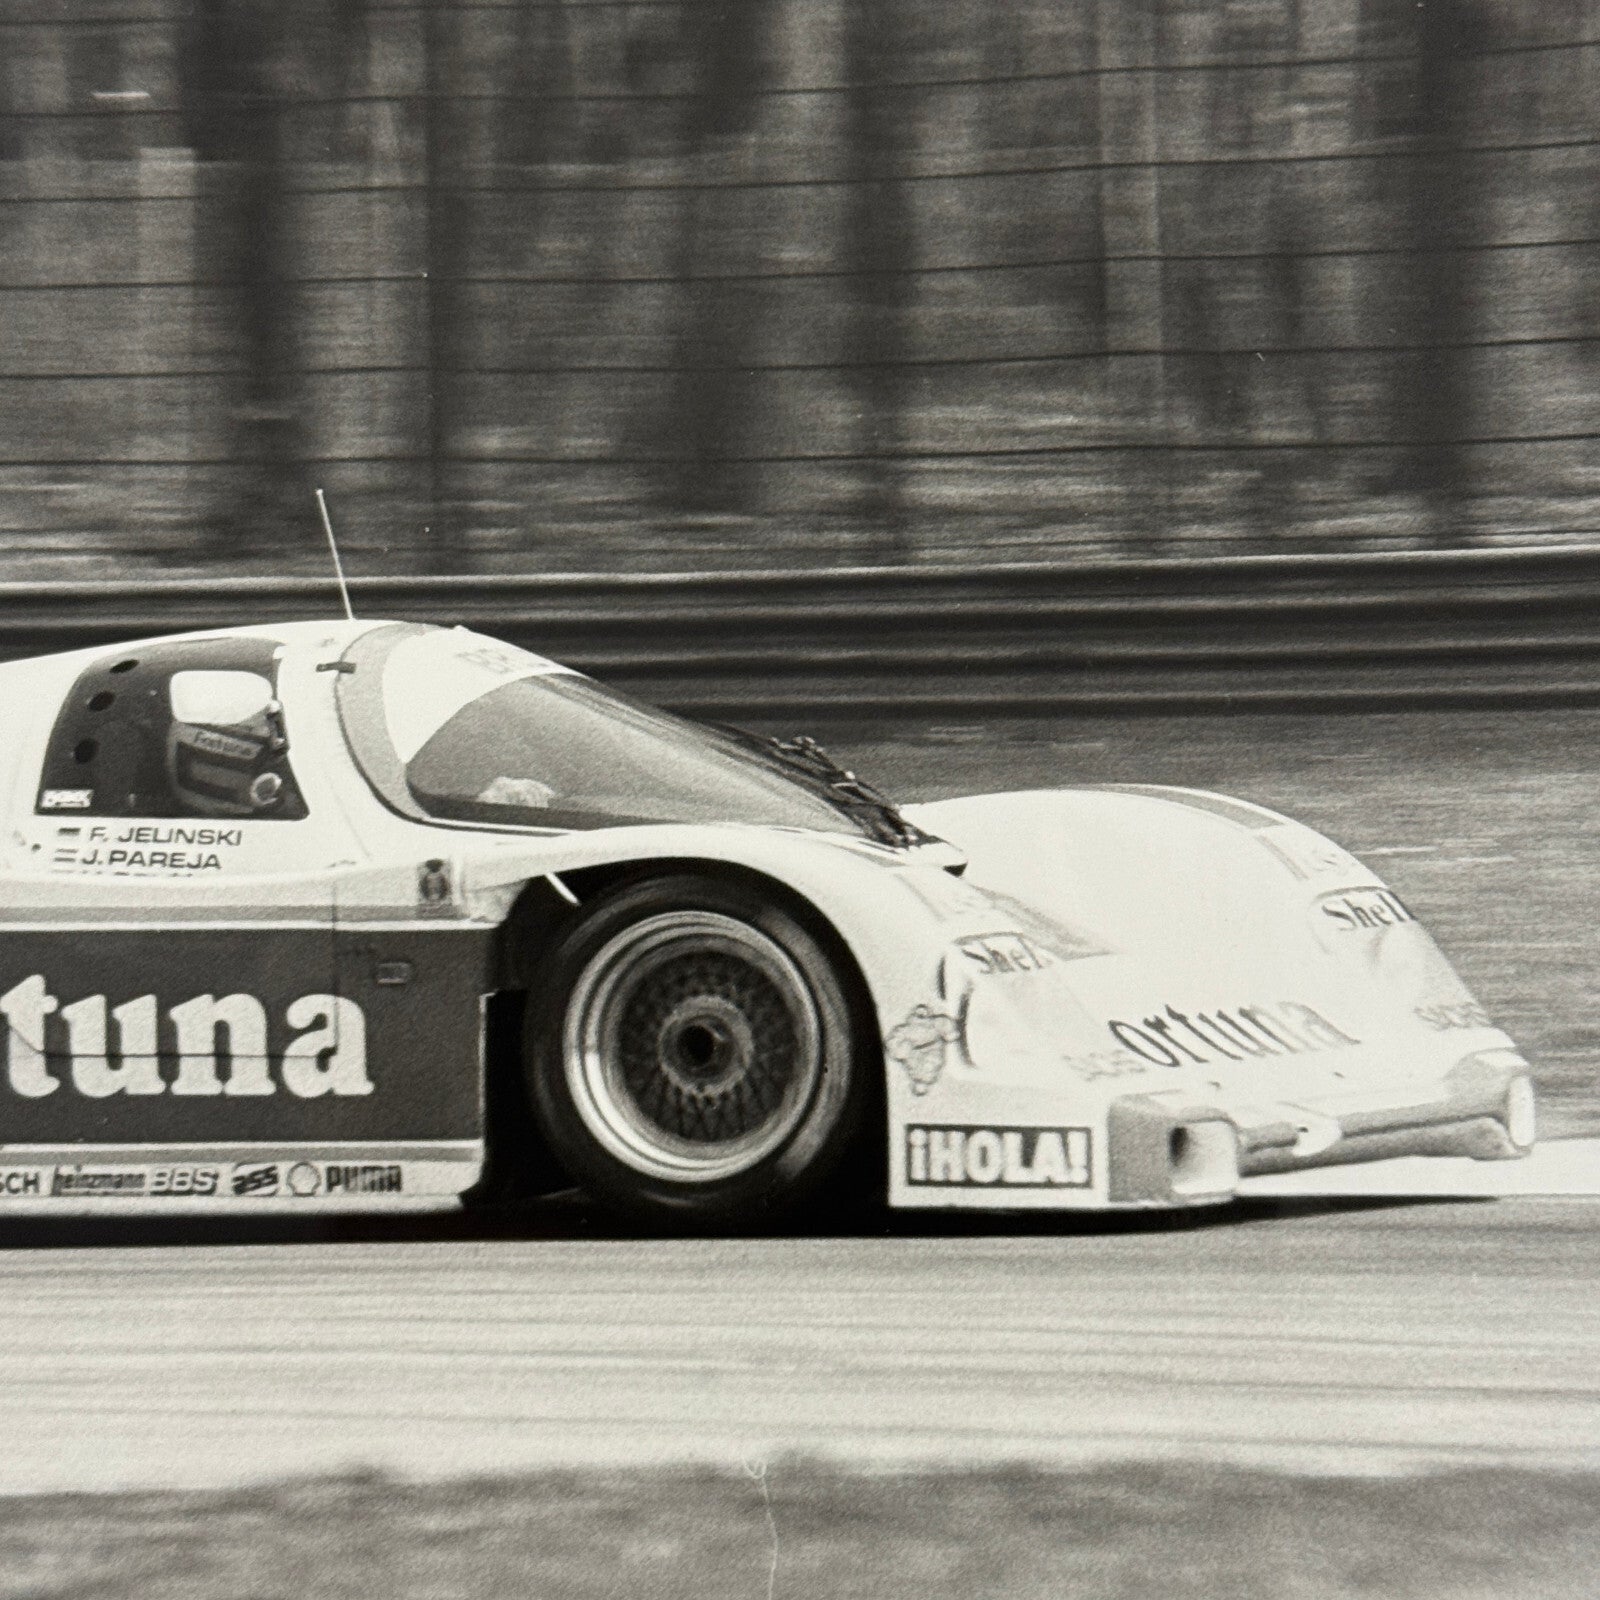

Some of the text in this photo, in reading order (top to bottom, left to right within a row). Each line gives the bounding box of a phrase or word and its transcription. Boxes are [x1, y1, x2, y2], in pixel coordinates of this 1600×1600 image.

[89, 826, 243, 847] F. JELINSKI
[1321, 889, 1419, 931] Shell
[961, 935, 1053, 975] Shel
[0, 974, 375, 1098] tuna
[909, 1129, 1088, 1184] ¡HOLA!
[150, 1166, 218, 1196] BBS
